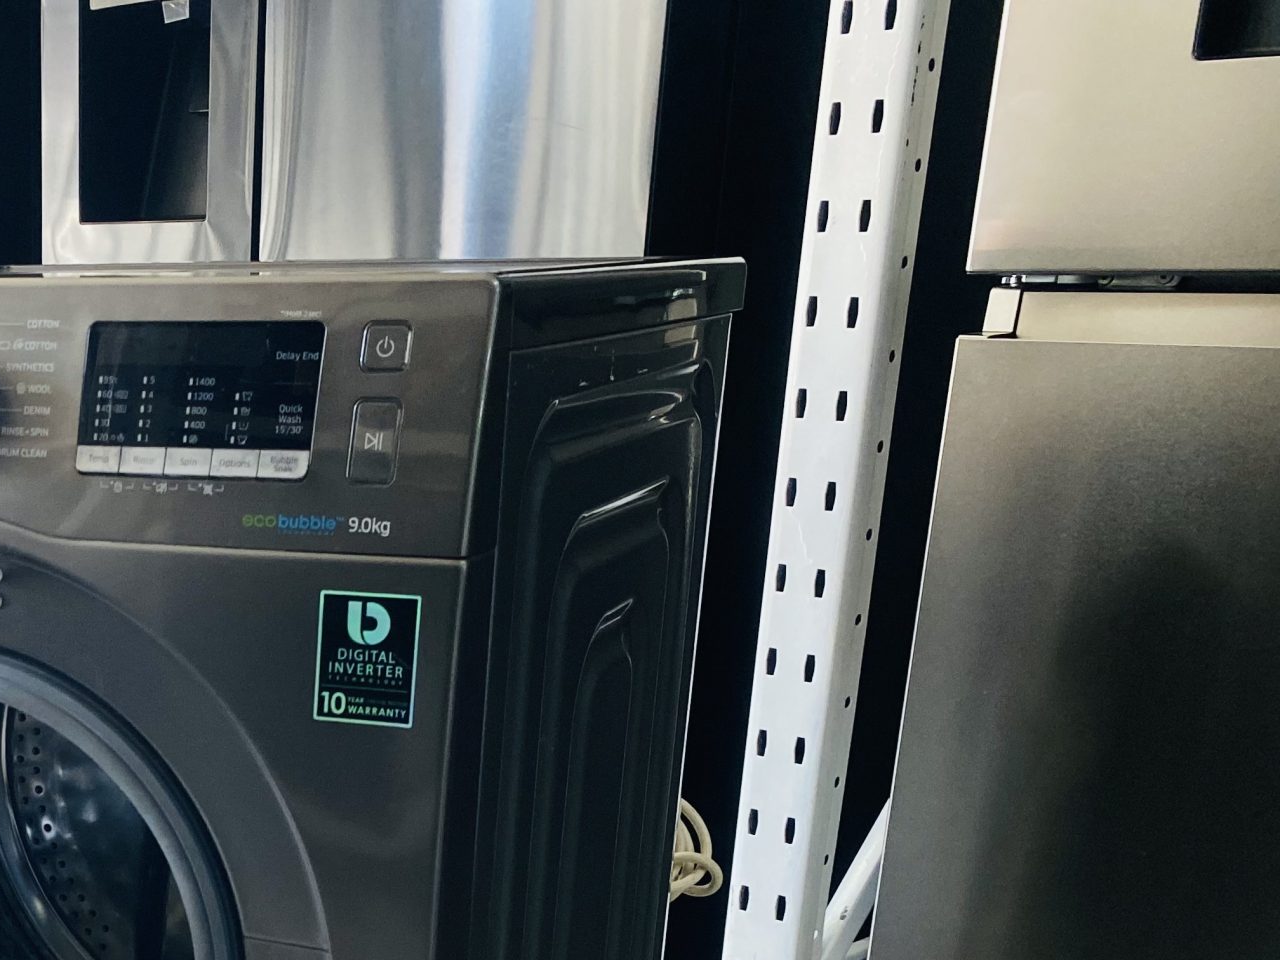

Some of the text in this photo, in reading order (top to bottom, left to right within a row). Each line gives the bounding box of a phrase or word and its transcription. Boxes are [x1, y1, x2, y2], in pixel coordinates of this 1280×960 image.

[26, 319, 60, 329] COTTON
[276, 351, 320, 361] Delay End
[6, 362, 55, 373] SYNTHETICS
[195, 377, 216, 386] 1400
[28, 385, 52, 394] WOOL
[193, 392, 214, 401] 1200
[23, 406, 51, 416] DENIM
[191, 406, 207, 415] 800
[278, 404, 303, 414] Quick
[190, 420, 206, 429] 400
[278, 415, 302, 424] Wash
[21, 448, 48, 458] CLEAN
[348, 516, 391, 537] 9.0kg
[337, 647, 396, 664] DIGITAL
[328, 661, 404, 679] INVERTER
[320, 691, 347, 715] 10
[347, 705, 407, 719] WARRANTY
